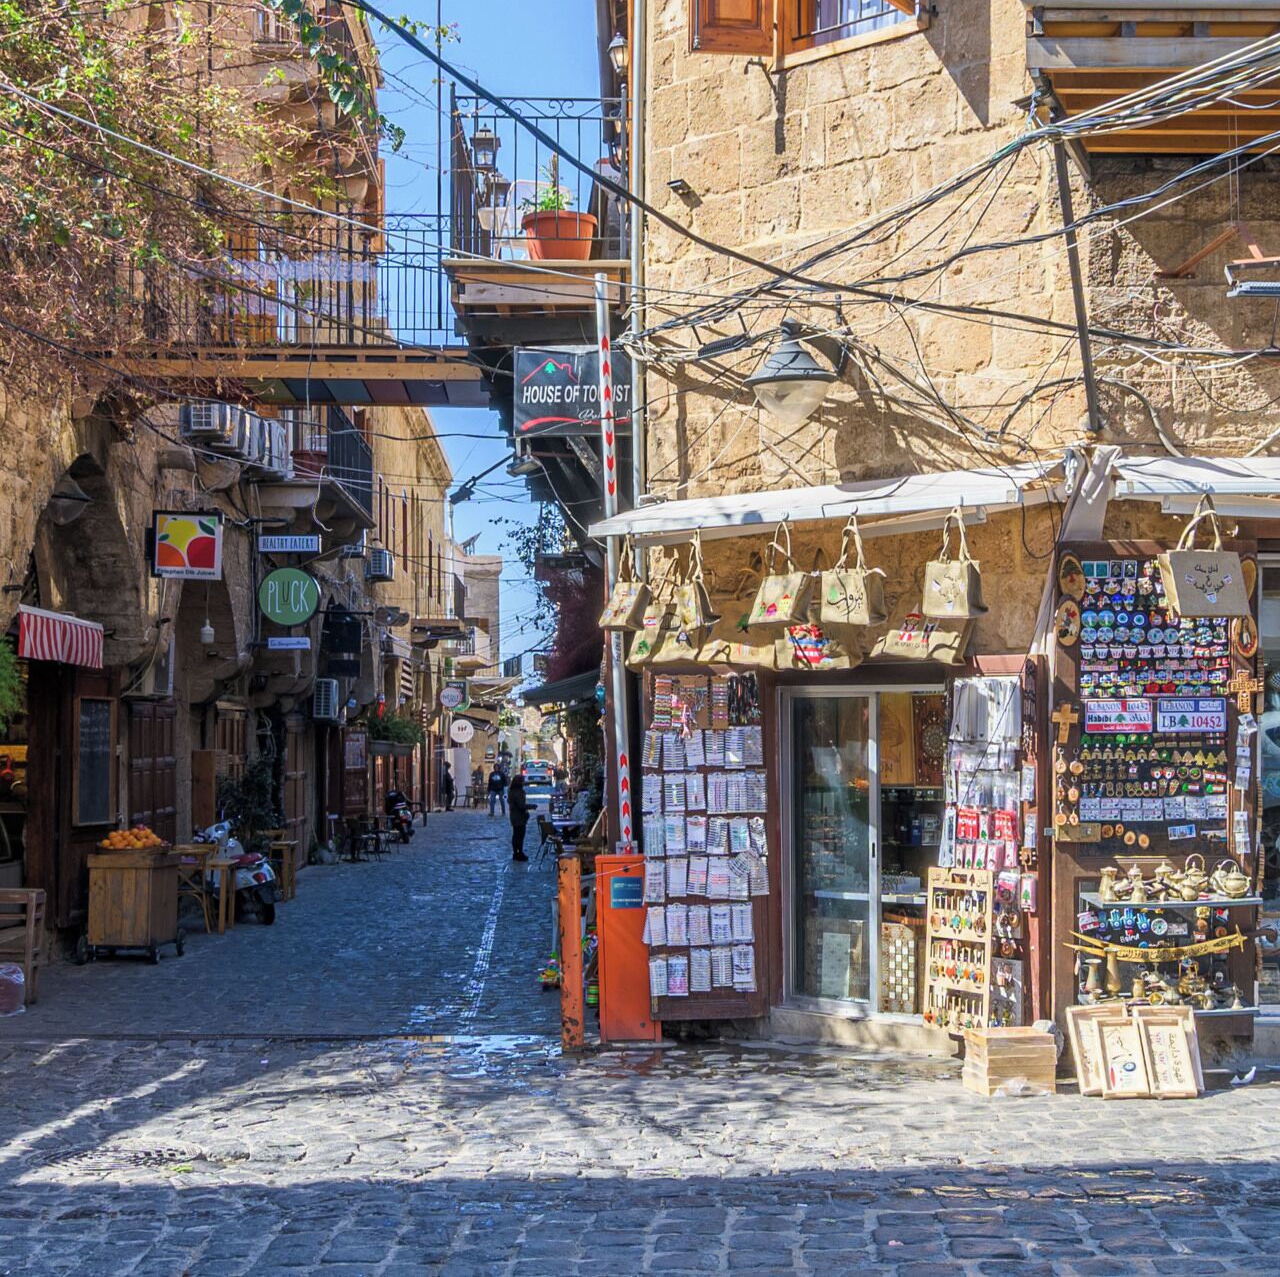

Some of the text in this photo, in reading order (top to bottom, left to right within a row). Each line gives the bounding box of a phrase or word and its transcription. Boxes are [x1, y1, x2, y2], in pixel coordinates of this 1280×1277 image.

[523, 385, 562, 404] HOUSE
[564, 385, 580, 403] OF
[261, 536, 314, 550] HEALTHY EATERY
[267, 580, 310, 613] PLUCK
[1161, 701, 1194, 711] LEBANON
[1088, 714, 1112, 722] Habibi
[1162, 715, 1222, 728] LB 10452
